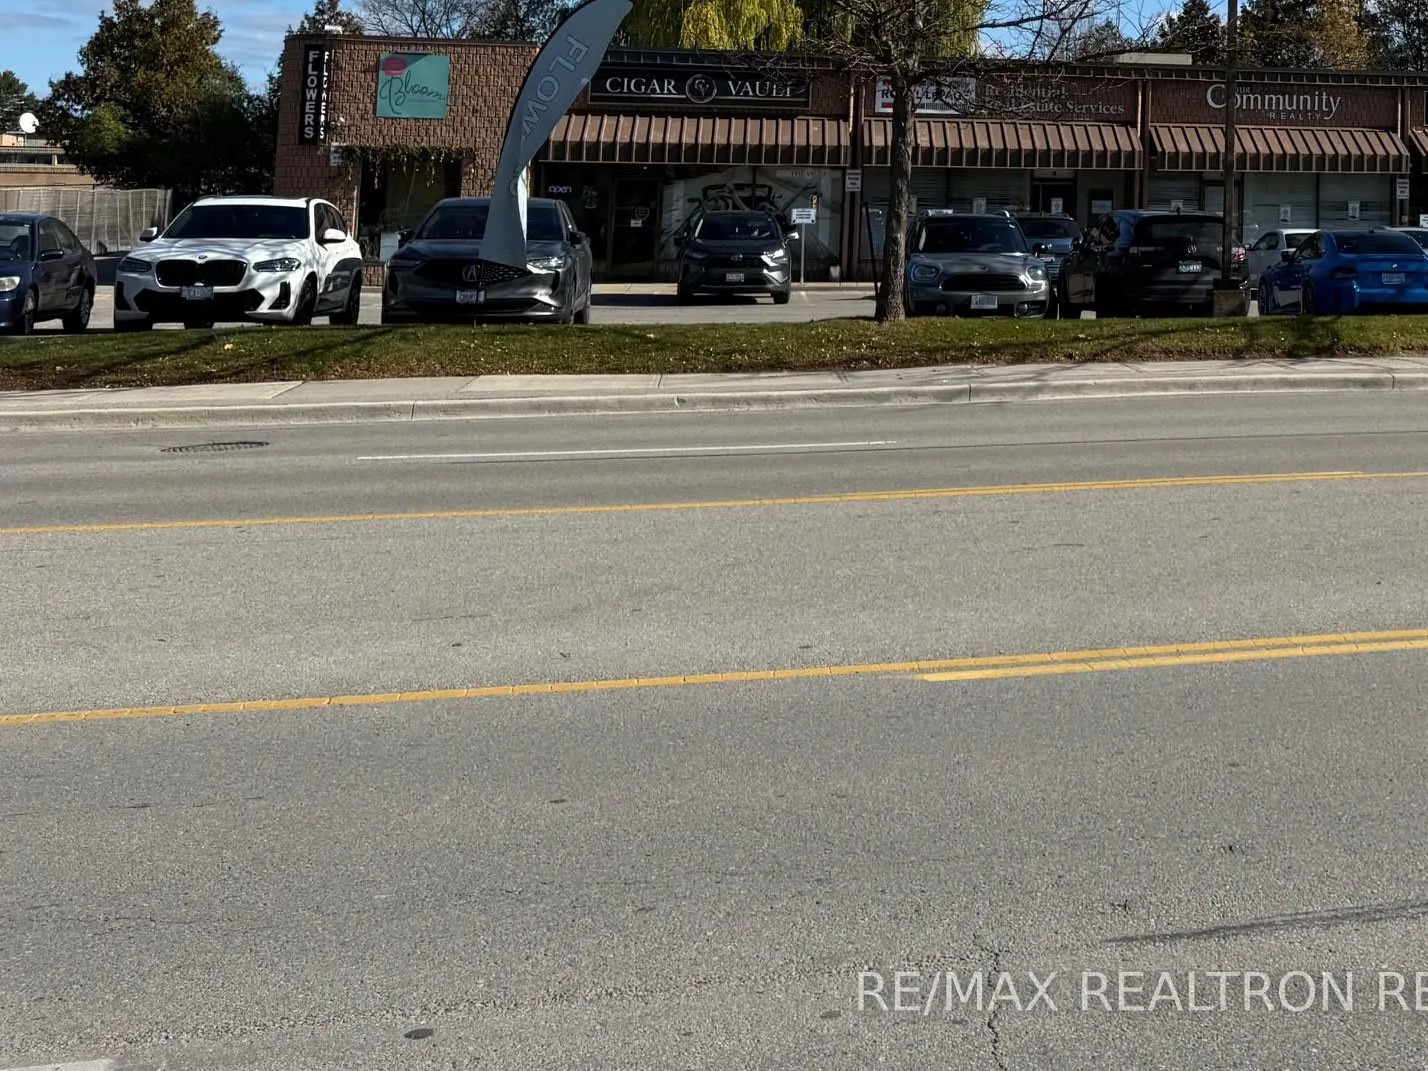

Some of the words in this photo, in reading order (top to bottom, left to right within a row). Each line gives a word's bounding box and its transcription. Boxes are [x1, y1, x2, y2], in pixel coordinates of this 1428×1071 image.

[303, 50, 320, 139] FLOWERS
[379, 70, 446, 115] Bloom
[605, 76, 678, 94] CIGAR
[727, 80, 792, 97] VAULT
[1066, 100, 1125, 114] Services
[1206, 83, 1341, 120] Community
[1269, 112, 1322, 120] REALTY
[548, 185, 572, 194] open
